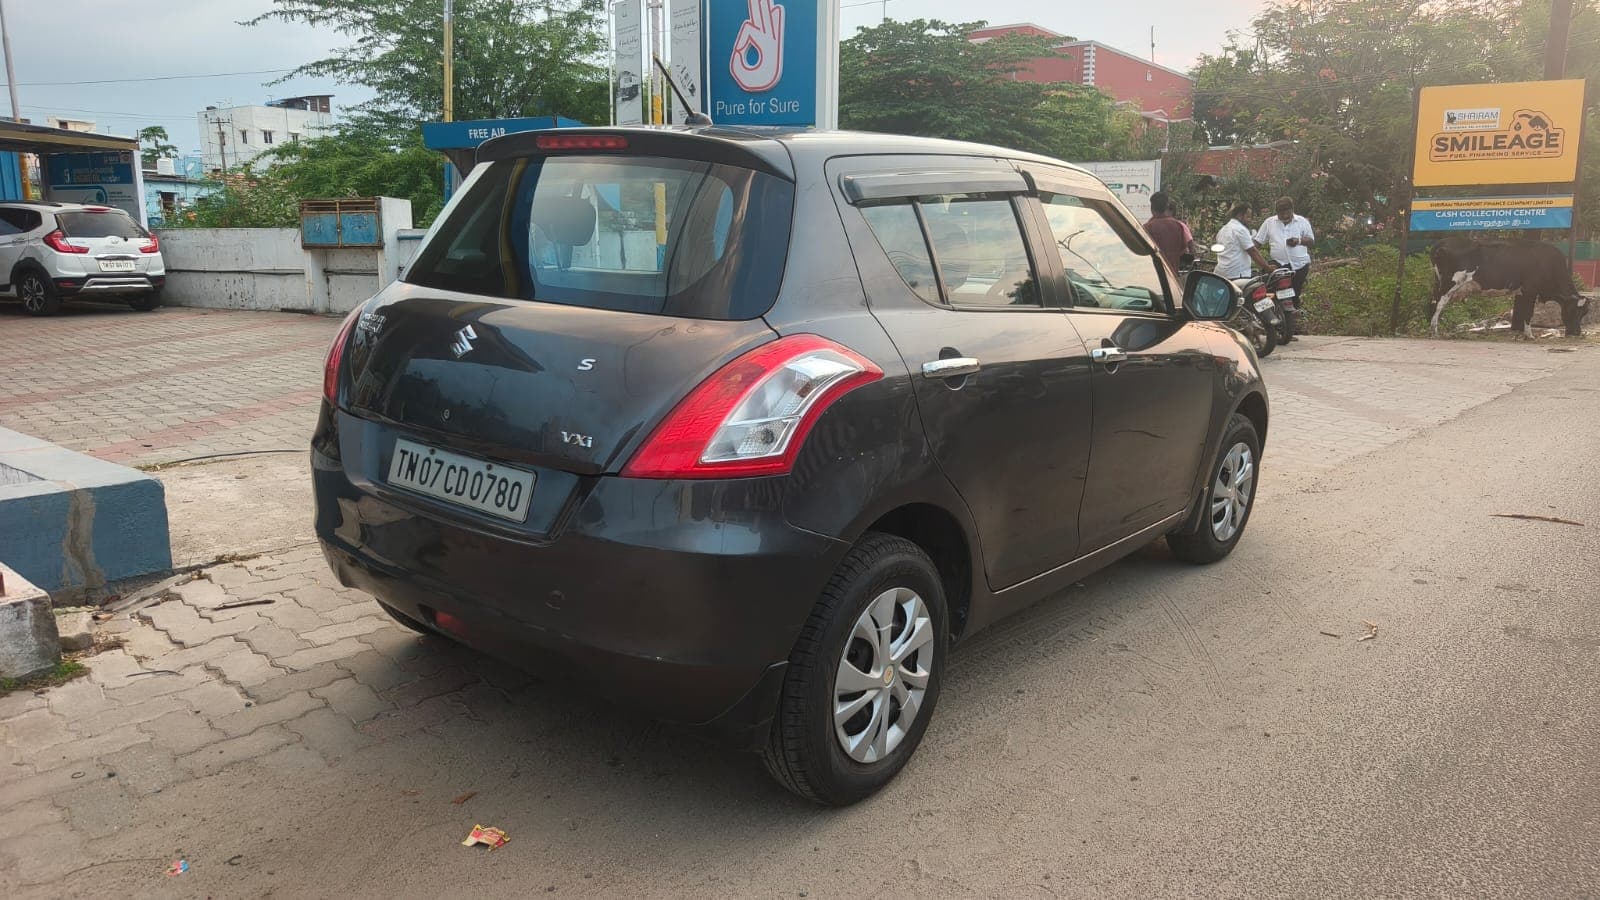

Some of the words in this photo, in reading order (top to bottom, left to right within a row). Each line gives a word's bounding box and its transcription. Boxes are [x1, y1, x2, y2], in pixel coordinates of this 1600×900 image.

[716, 101, 745, 116] Pure
[749, 99, 766, 114] for
[769, 97, 800, 113] Sure
[1457, 111, 1499, 121] SHRIRAM
[468, 128, 489, 139] FREE
[491, 127, 506, 138] AIR
[1434, 131, 1560, 153] SMILEAGE
[1460, 209, 1511, 217] COLLECTION
[1513, 208, 1547, 216] CENTRE
[577, 358, 597, 371] S
